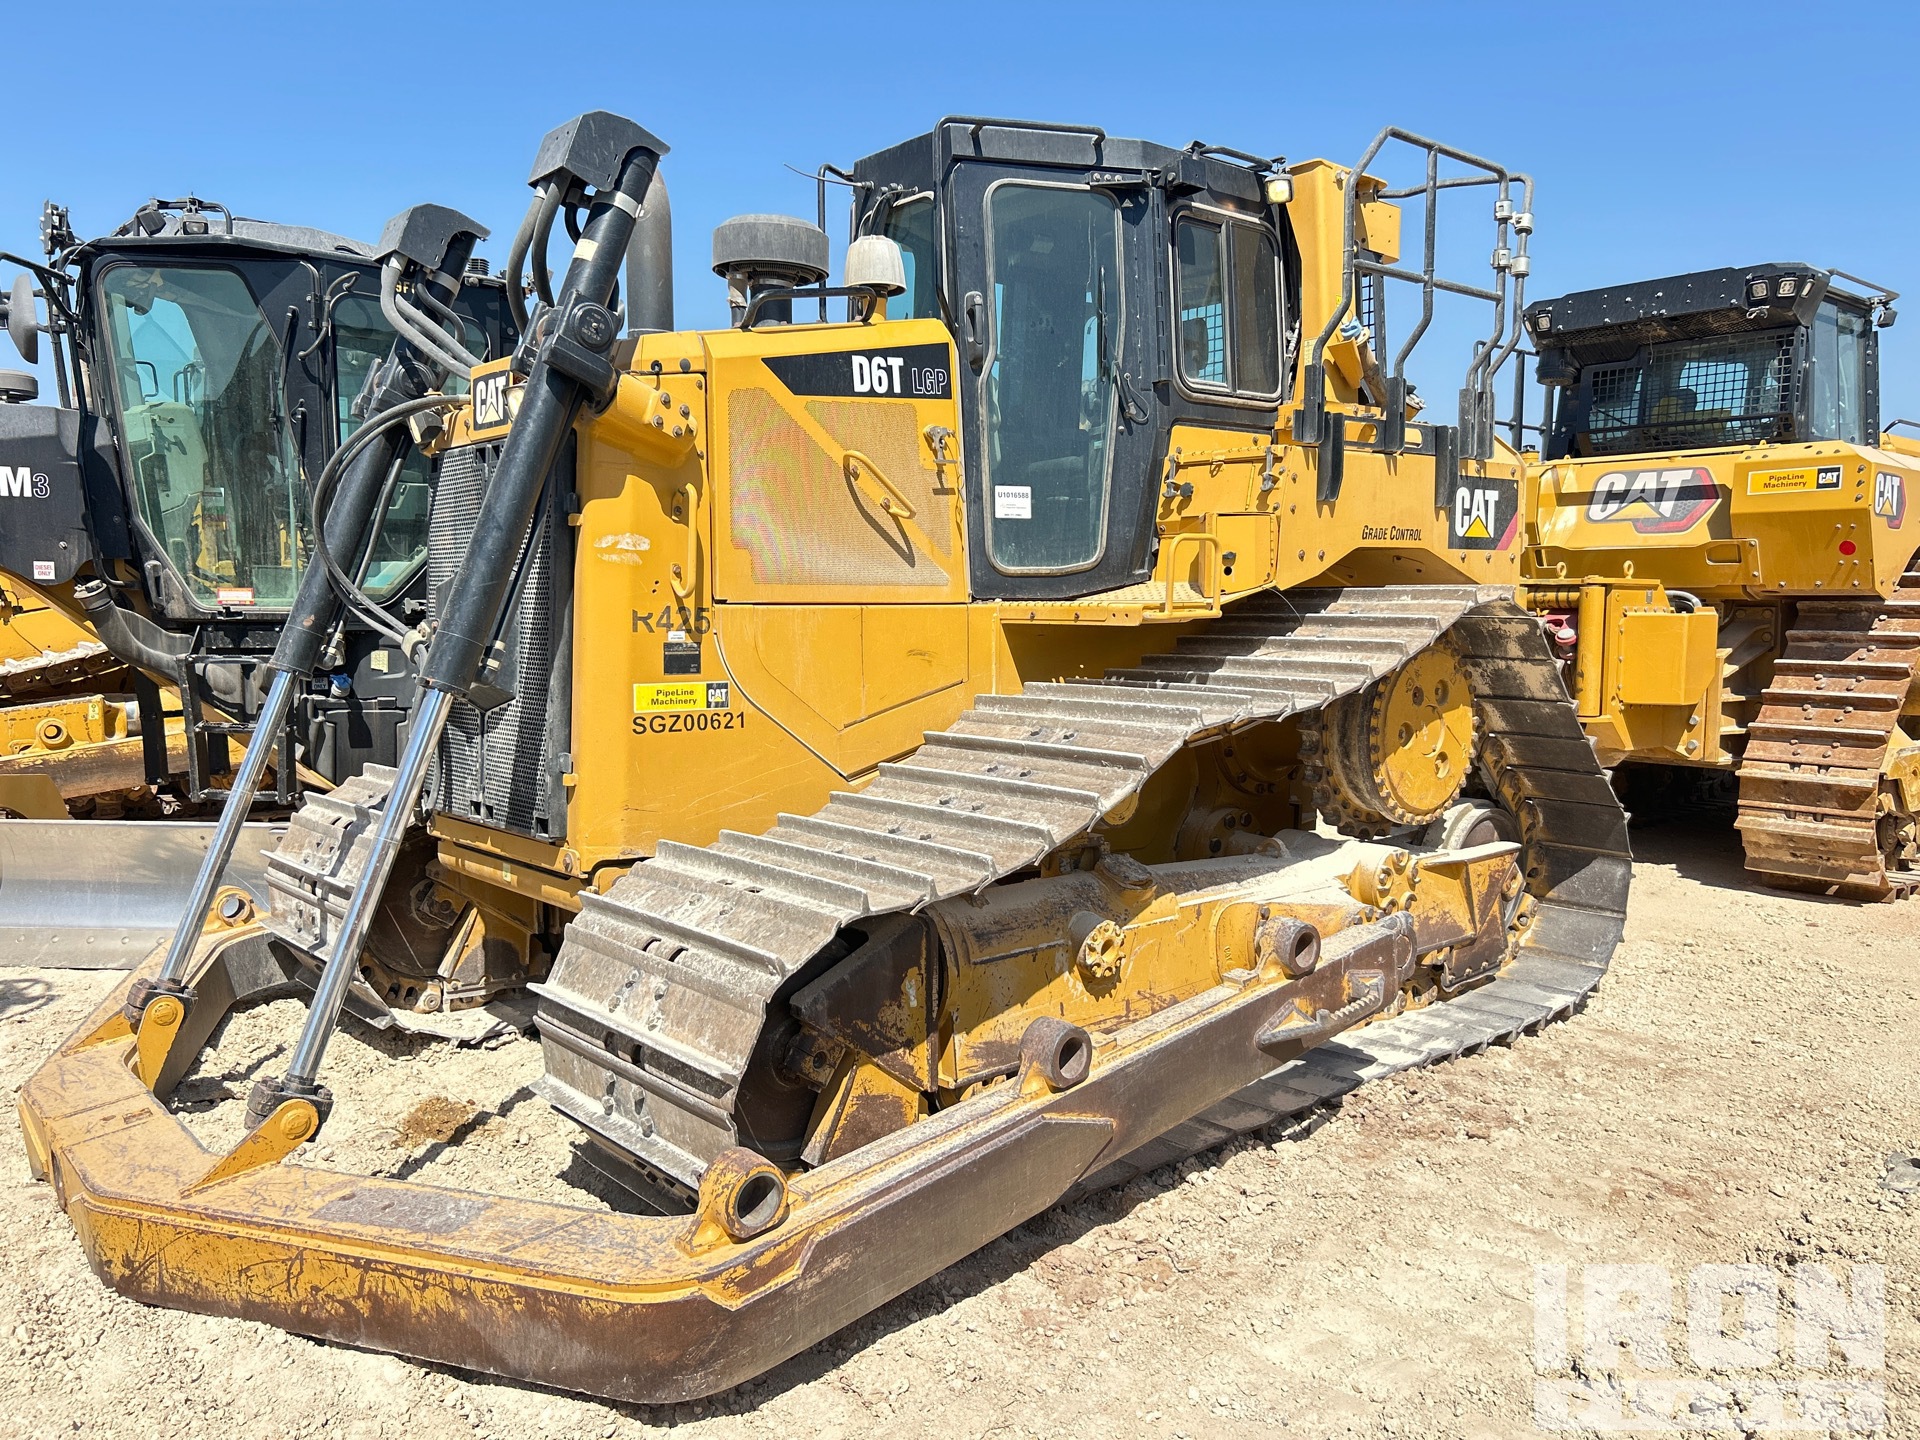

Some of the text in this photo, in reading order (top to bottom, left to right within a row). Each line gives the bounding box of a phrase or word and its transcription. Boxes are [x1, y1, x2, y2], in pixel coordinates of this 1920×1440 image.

[851, 354, 947, 395] D6T LGP
[475, 375, 507, 425] CAT
[1763, 481, 1807, 489] Machinery
[1768, 473, 1805, 482] PipeLine
[1818, 472, 1840, 485] CAT
[997, 491, 1030, 499] U1016588
[1588, 469, 1694, 521] CAT
[1875, 472, 1901, 517] CAT
[1455, 486, 1499, 538] CAT
[632, 605, 711, 635] R425
[650, 697, 698, 706] Machinery
[656, 689, 695, 698] PipeLine
[708, 688, 728, 702] CAT
[632, 711, 745, 734] SGZ00621
